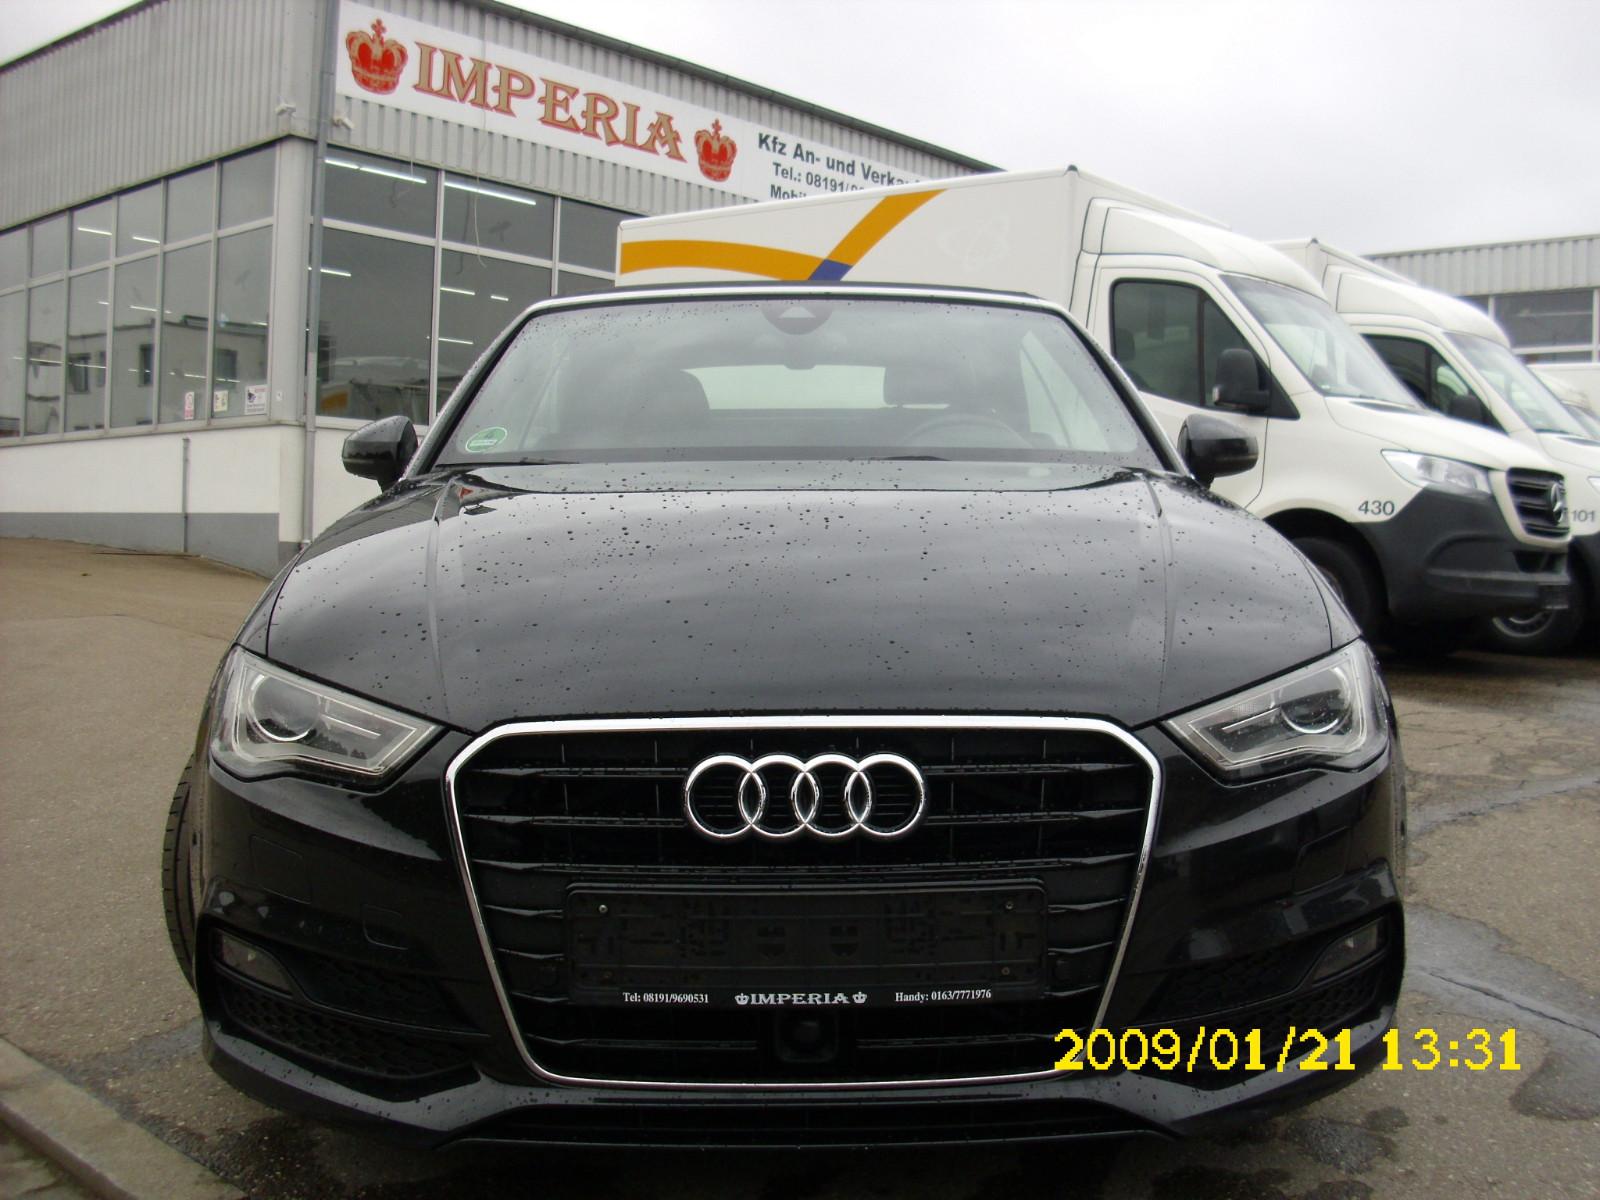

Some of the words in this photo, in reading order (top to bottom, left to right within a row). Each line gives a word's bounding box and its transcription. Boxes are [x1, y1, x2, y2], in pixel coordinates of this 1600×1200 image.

[412, 41, 687, 163] IMPERIA
[758, 132, 787, 156] Kfz
[792, 143, 820, 164] An-
[826, 156, 856, 177] und
[772, 161, 802, 183] Tel.:
[1358, 500, 1396, 516] 430
[622, 991, 641, 1003] Tel:
[643, 992, 709, 1004] 08191/9690531
[750, 993, 850, 1005] IMPERIA
[895, 992, 929, 1004] Handy:
[931, 989, 992, 1001] 0163/7771976
